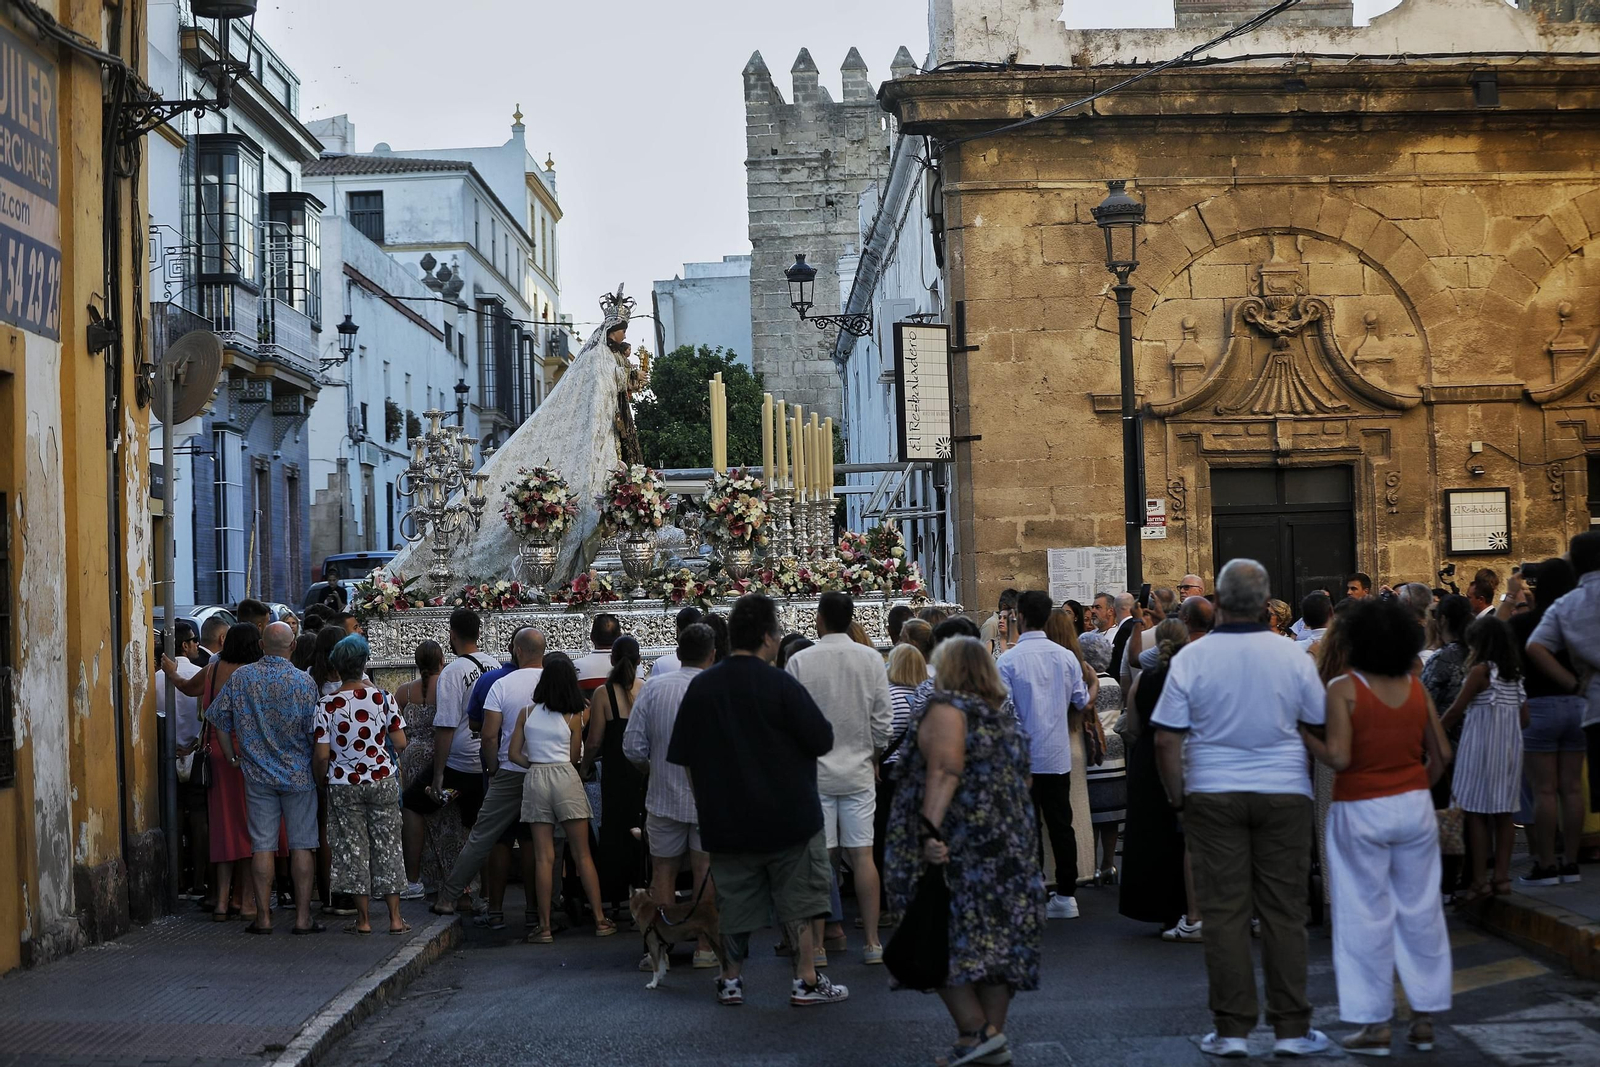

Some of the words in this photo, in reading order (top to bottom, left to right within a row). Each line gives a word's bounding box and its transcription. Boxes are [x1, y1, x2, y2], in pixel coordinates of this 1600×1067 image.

[6, 238, 25, 318] 54
[26, 247, 45, 326] 23
[46, 256, 62, 333] 23
[905, 331, 920, 431] Resbaladero
[908, 436, 921, 452] El
[463, 669, 479, 689] Los
